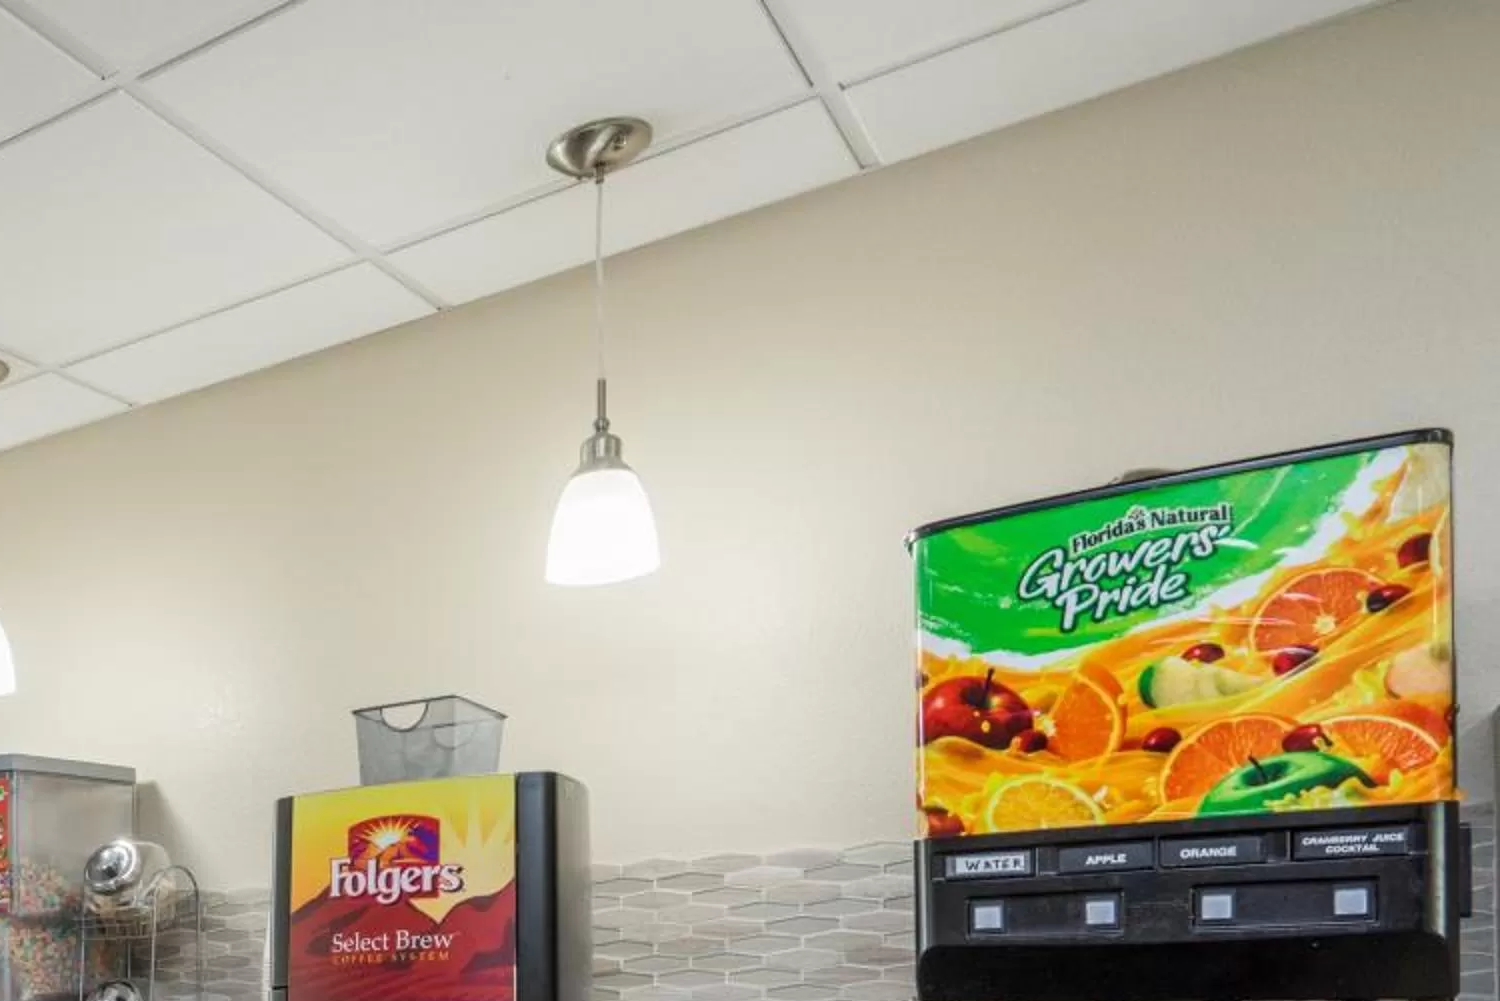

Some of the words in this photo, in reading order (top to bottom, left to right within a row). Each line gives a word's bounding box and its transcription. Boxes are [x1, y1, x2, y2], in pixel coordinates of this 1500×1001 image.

[1151, 504, 1228, 529] Natural
[1054, 563, 1189, 632] Pride
[1302, 834, 1368, 846] CRANBERRY
[1372, 832, 1405, 843] JUICE
[1180, 846, 1238, 859] ORANGE
[1325, 845, 1381, 855] COCKTAIL
[965, 856, 1023, 872] WATER
[1085, 853, 1128, 866] APPLE
[329, 857, 465, 905] Folgers
[332, 931, 389, 953] Select
[395, 929, 454, 950] Brew
